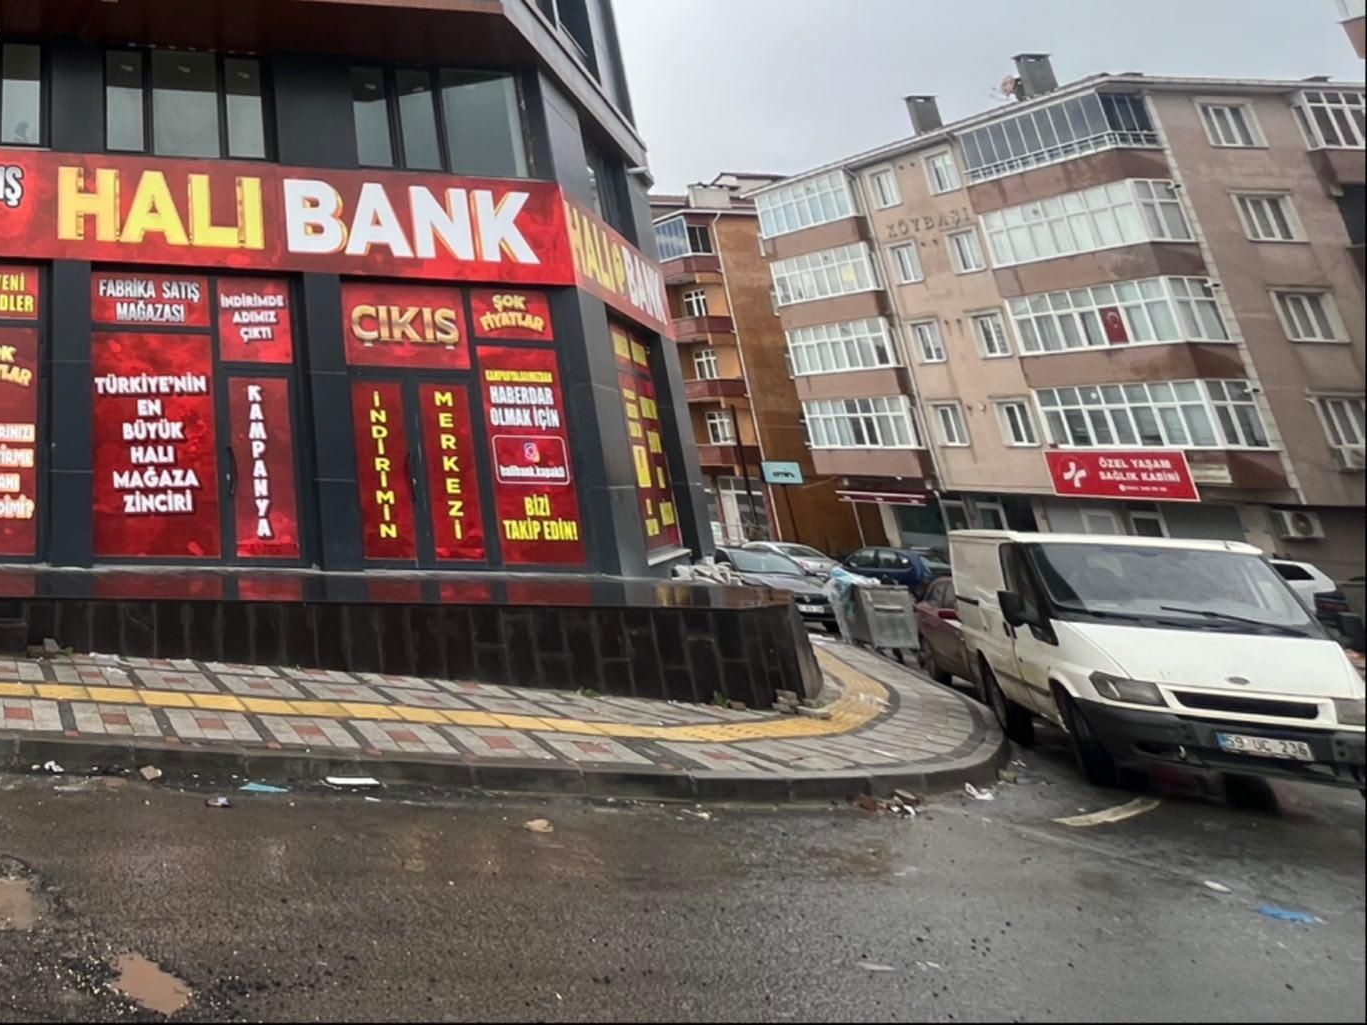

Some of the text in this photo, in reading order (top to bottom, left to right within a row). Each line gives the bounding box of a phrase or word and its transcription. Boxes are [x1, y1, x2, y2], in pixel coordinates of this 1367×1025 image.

[57, 166, 540, 264] HALI BANK
[563, 200, 667, 325] HALI BANK
[99, 278, 200, 302] FABRİKA SATIŞ
[220, 293, 284, 307] İNDİRİMDE
[116, 299, 185, 322] MAĞAZASI
[492, 294, 527, 312] ŞOK
[232, 311, 277, 324] ADIMIZ
[350, 304, 461, 350] ÇIKIŞ
[480, 312, 544, 332] FİYATLAR
[239, 326, 272, 343] ÇIKTI
[94, 373, 207, 396] TÜRKİYE'NİN
[490, 386, 554, 405] HABERDAR
[137, 399, 162, 417] EN
[490, 406, 560, 430] OLMAK İÇİN
[122, 420, 184, 441] BÜYÜK
[130, 445, 175, 464] HALI
[247, 385, 274, 537] KAMPANYA
[369, 391, 397, 539] İNDİRİMİN
[434, 391, 467, 540] MERKEZİ
[1099, 457, 1128, 469] ÖZEL
[112, 466, 200, 489] MAĞAZA
[123, 491, 193, 514] ZİNCİRİ
[524, 494, 551, 516] BİZİ
[503, 519, 578, 541] TAKİP EDİN!
